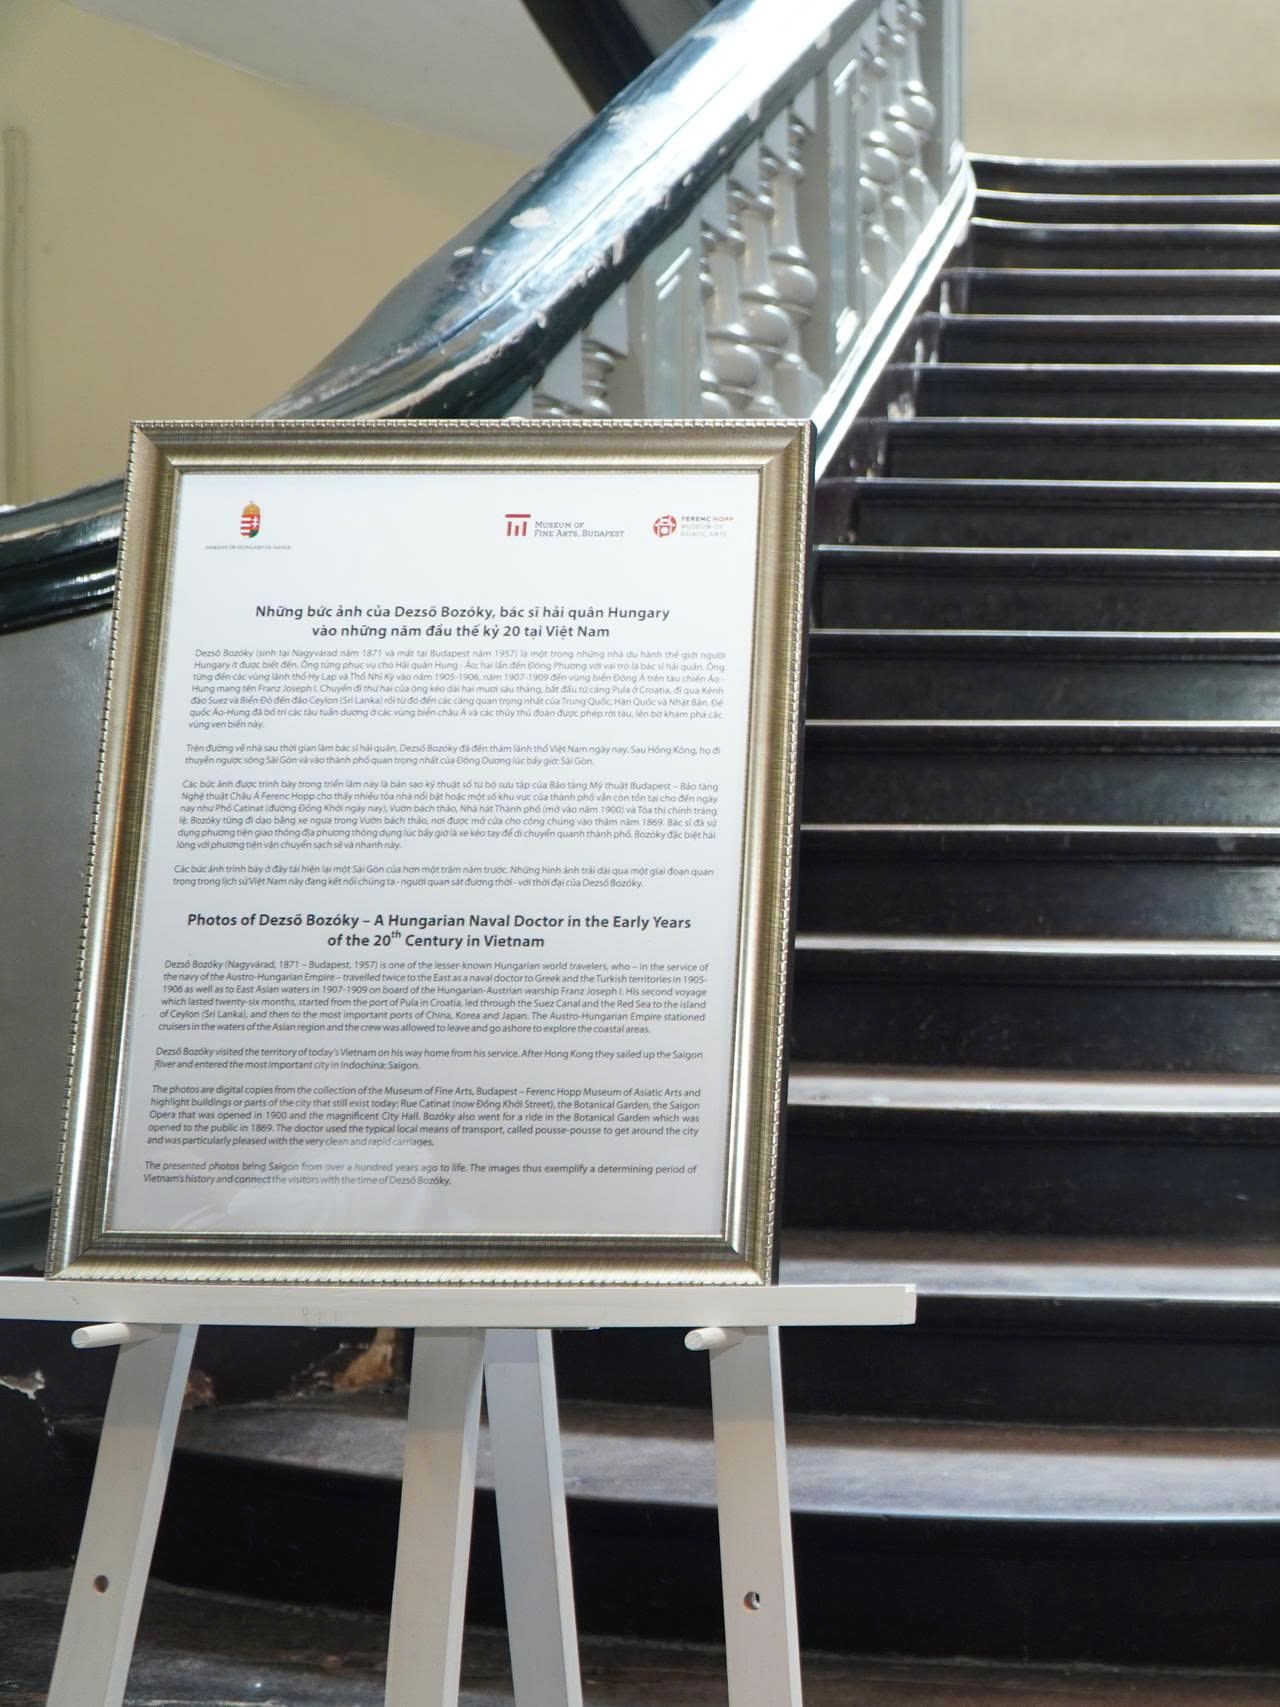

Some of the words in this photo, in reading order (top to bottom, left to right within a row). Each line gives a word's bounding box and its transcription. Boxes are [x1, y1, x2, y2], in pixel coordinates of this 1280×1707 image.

[255, 605, 303, 620] Những
[306, 605, 332, 617] bức
[335, 604, 362, 617] ảnh
[366, 604, 390, 617] của
[440, 605, 495, 620] Bozóky,
[499, 606, 524, 617] bác
[528, 606, 539, 617] sĩ
[542, 605, 564, 617] hải
[567, 606, 604, 620] quân
[607, 606, 669, 621] Hungary
[312, 624, 337, 636] vào
[340, 624, 387, 639] những
[390, 625, 422, 636] năm
[425, 623, 452, 636] đầu
[455, 623, 479, 636] thế
[482, 624, 499, 639] kỷ
[502, 625, 520, 636] 20
[524, 625, 542, 639] tại
[545, 625, 573, 640] Việt
[576, 625, 610, 636] Nam
[187, 913, 237, 926] Photos
[240, 912, 256, 926] of
[305, 913, 359, 929] Bozóky
[374, 914, 384, 926] A
[387, 914, 465, 931] Hungarian
[468, 914, 510, 926] Naval
[513, 914, 563, 927] Doctor
[567, 915, 581, 927] in
[584, 914, 609, 927] the
[612, 915, 649, 931] Early
[652, 916, 691, 928] Years
[327, 933, 343, 946] of
[345, 933, 370, 946] the
[404, 934, 463, 950] Century
[466, 934, 480, 946] in
[483, 934, 544, 947] Vietnam
[192, 959, 223, 970] Bozóky
[224, 959, 276, 970] (Nagyvárad,
[279, 960, 298, 968] 1871
[308, 960, 351, 970] Budapest,
[354, 960, 378, 969] 1957)
[379, 961, 386, 969] is
[406, 959, 416, 969] of
[417, 960, 433, 969] the
[433, 960, 492, 969] lesser-known
[494, 961, 540, 972] Hungarian
[542, 961, 567, 970] world
[569, 961, 608, 971] travelers,
[611, 962, 630, 970] who
[639, 962, 648, 970] in
[650, 962, 664, 971] the
[666, 963, 697, 971] service
[699, 961, 708, 971] of
[154, 1059, 175, 1071] River
[176, 1059, 193, 1068] and
[194, 1059, 228, 1068] entered
[229, 1059, 244, 1068] the
[268, 1060, 312, 1070] important
[314, 1060, 329, 1071] city
[340, 1060, 386, 1069] Indochina:
[387, 1060, 419, 1072] Saigon.
[149, 1109, 176, 1120] Opera
[178, 1110, 195, 1119] that
[217, 1110, 251, 1120] opened
[253, 1110, 262, 1119] in
[266, 1110, 287, 1119] 1900
[289, 1110, 306, 1119] and
[308, 1111, 323, 1120] the
[326, 1110, 379, 1122] magnificent
[381, 1111, 399, 1122] City
[401, 1111, 420, 1120] Hall.
[423, 1111, 455, 1122] Bozóky
[457, 1111, 475, 1121] also
[478, 1113, 500, 1121] went
[502, 1111, 514, 1121] for
[525, 1112, 542, 1121] ride
[545, 1112, 553, 1120] in
[556, 1112, 571, 1121] the
[573, 1112, 614, 1122] Botanical
[616, 1112, 649, 1122] Garden
[652, 1113, 679, 1122] which
